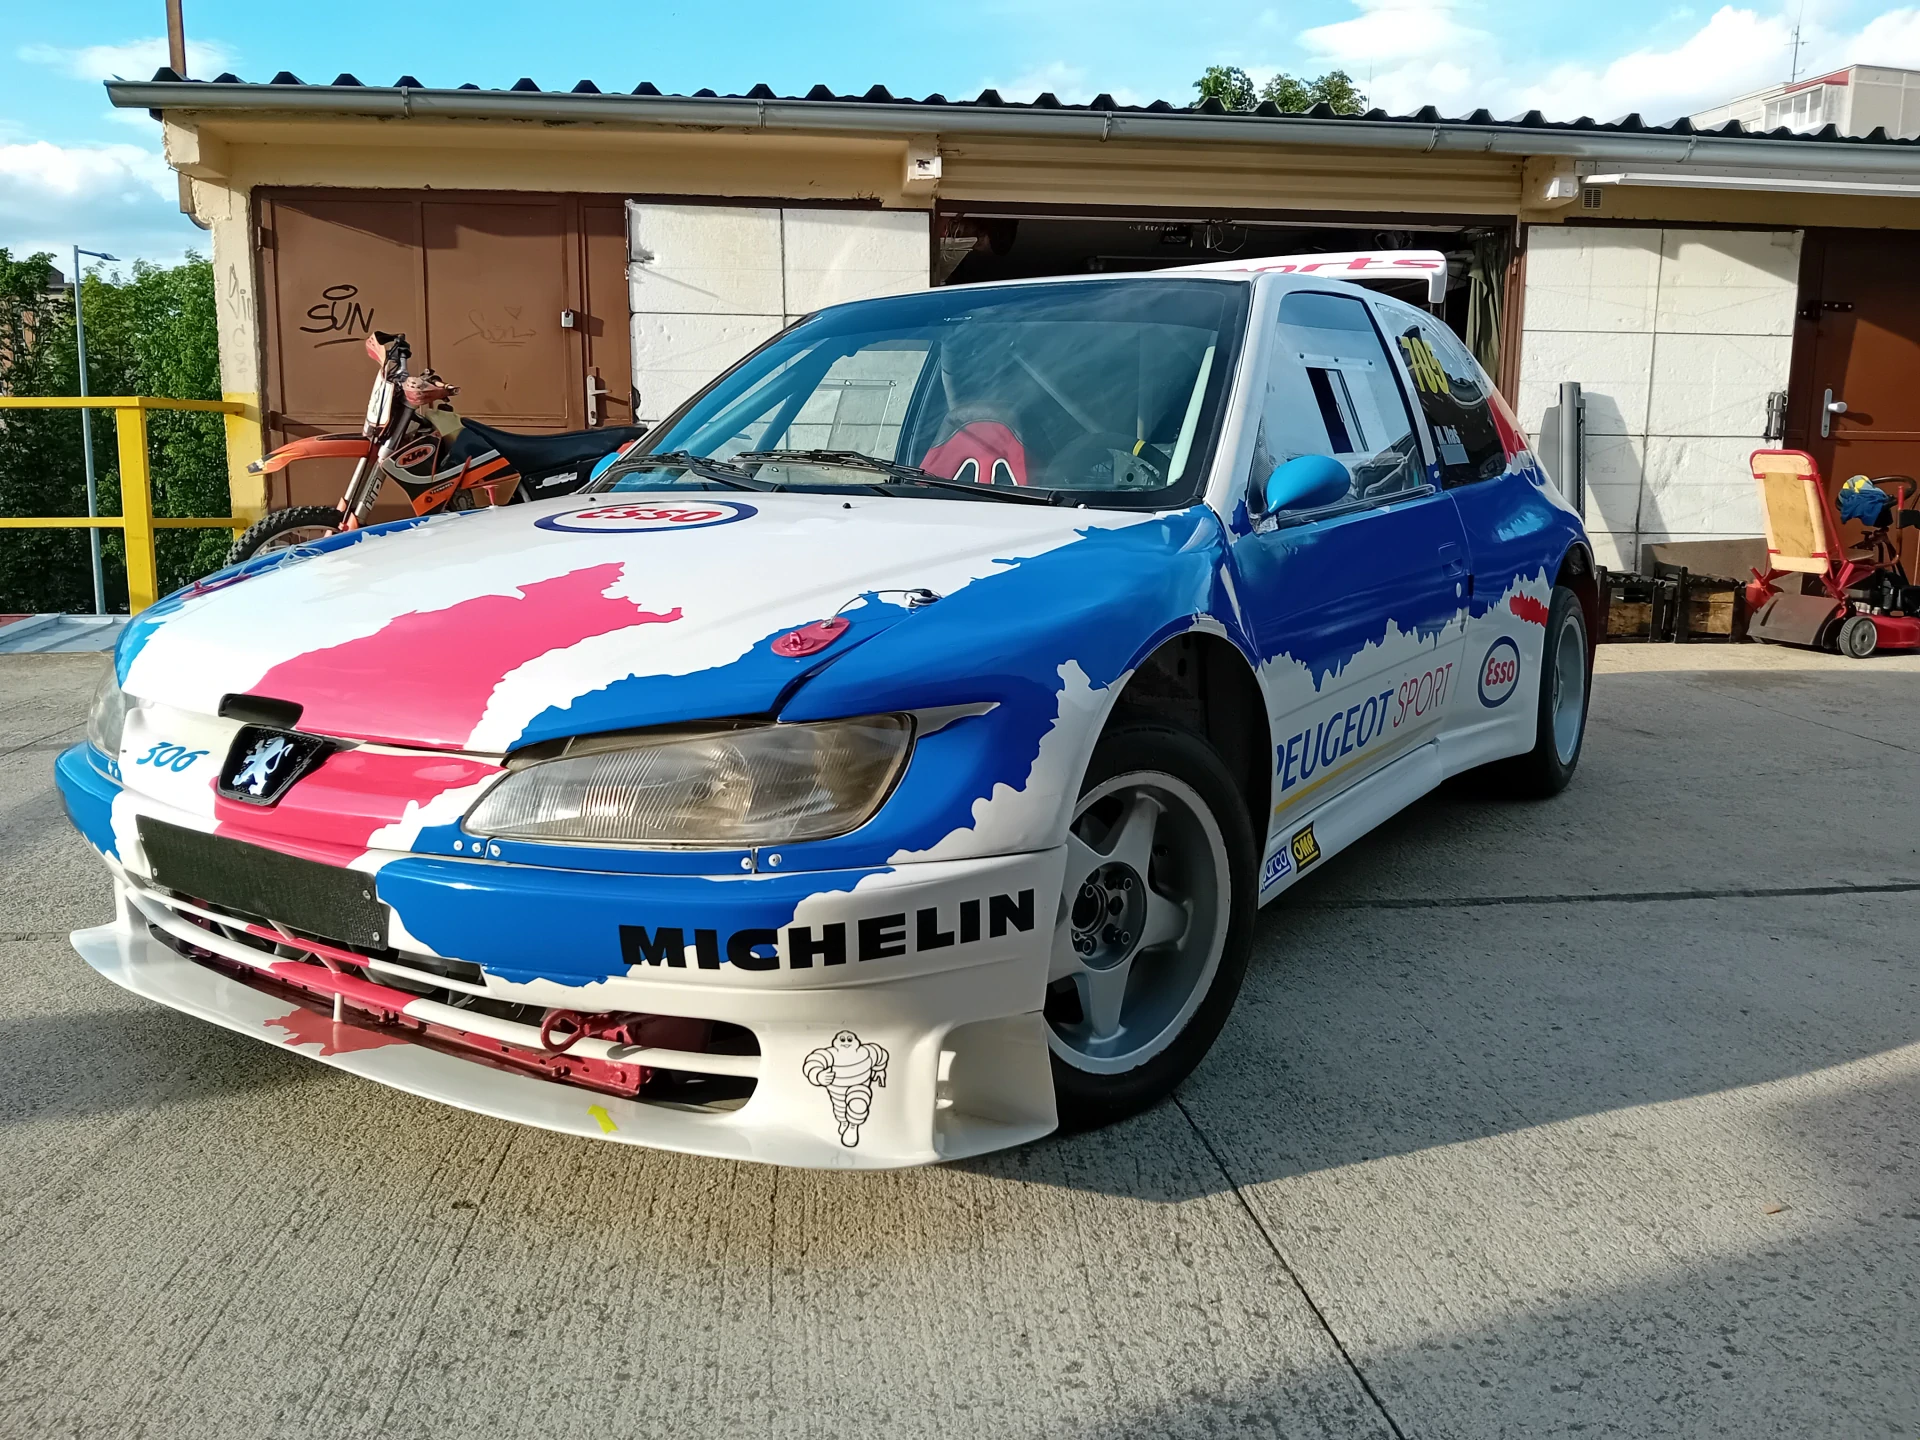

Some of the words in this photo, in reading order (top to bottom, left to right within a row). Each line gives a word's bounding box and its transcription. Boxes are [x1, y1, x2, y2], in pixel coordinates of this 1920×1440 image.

[1232, 258, 1445, 273] orts
[402, 448, 428, 465] KTM
[1393, 662, 1453, 728] SPORT
[136, 741, 210, 773] 306
[1293, 832, 1315, 860] OMP
[1260, 850, 1288, 891] arco
[618, 888, 1036, 971] MICHELIN
